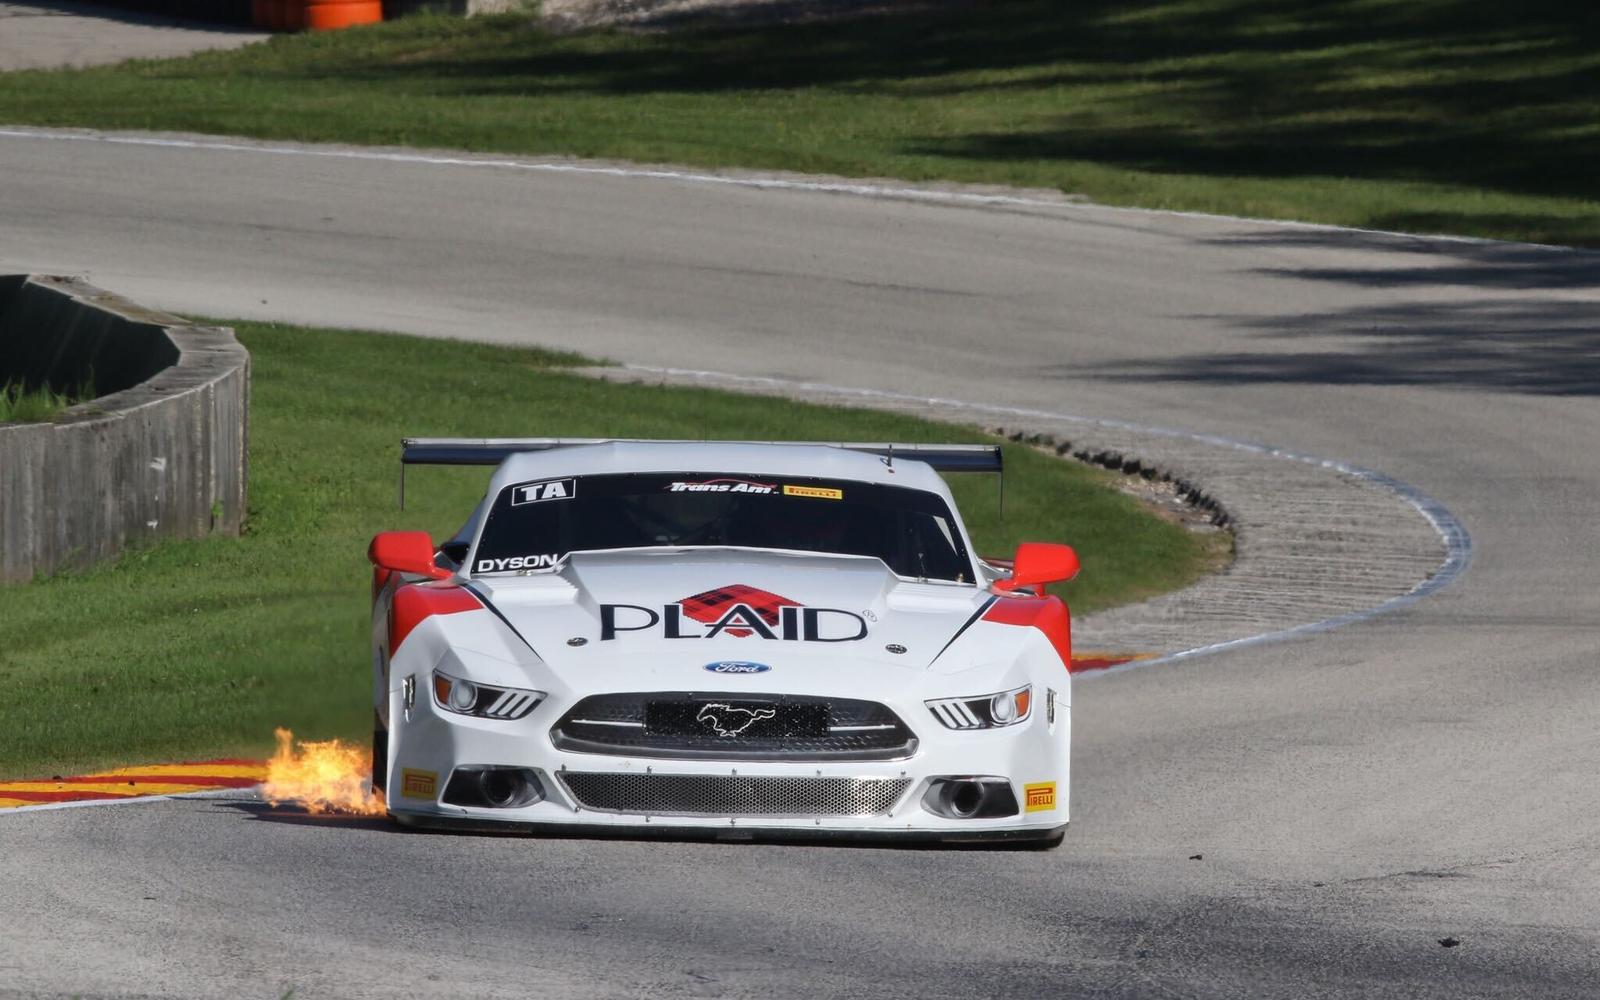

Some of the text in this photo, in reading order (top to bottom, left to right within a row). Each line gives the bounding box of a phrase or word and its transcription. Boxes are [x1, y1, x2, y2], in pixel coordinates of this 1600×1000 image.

[520, 482, 567, 501] TA
[671, 482, 772, 494] Trans Am
[477, 553, 558, 572] DYSON
[600, 603, 868, 642] PLAID
[715, 662, 761, 673] Ford
[1026, 787, 1053, 806] PIRELLI
